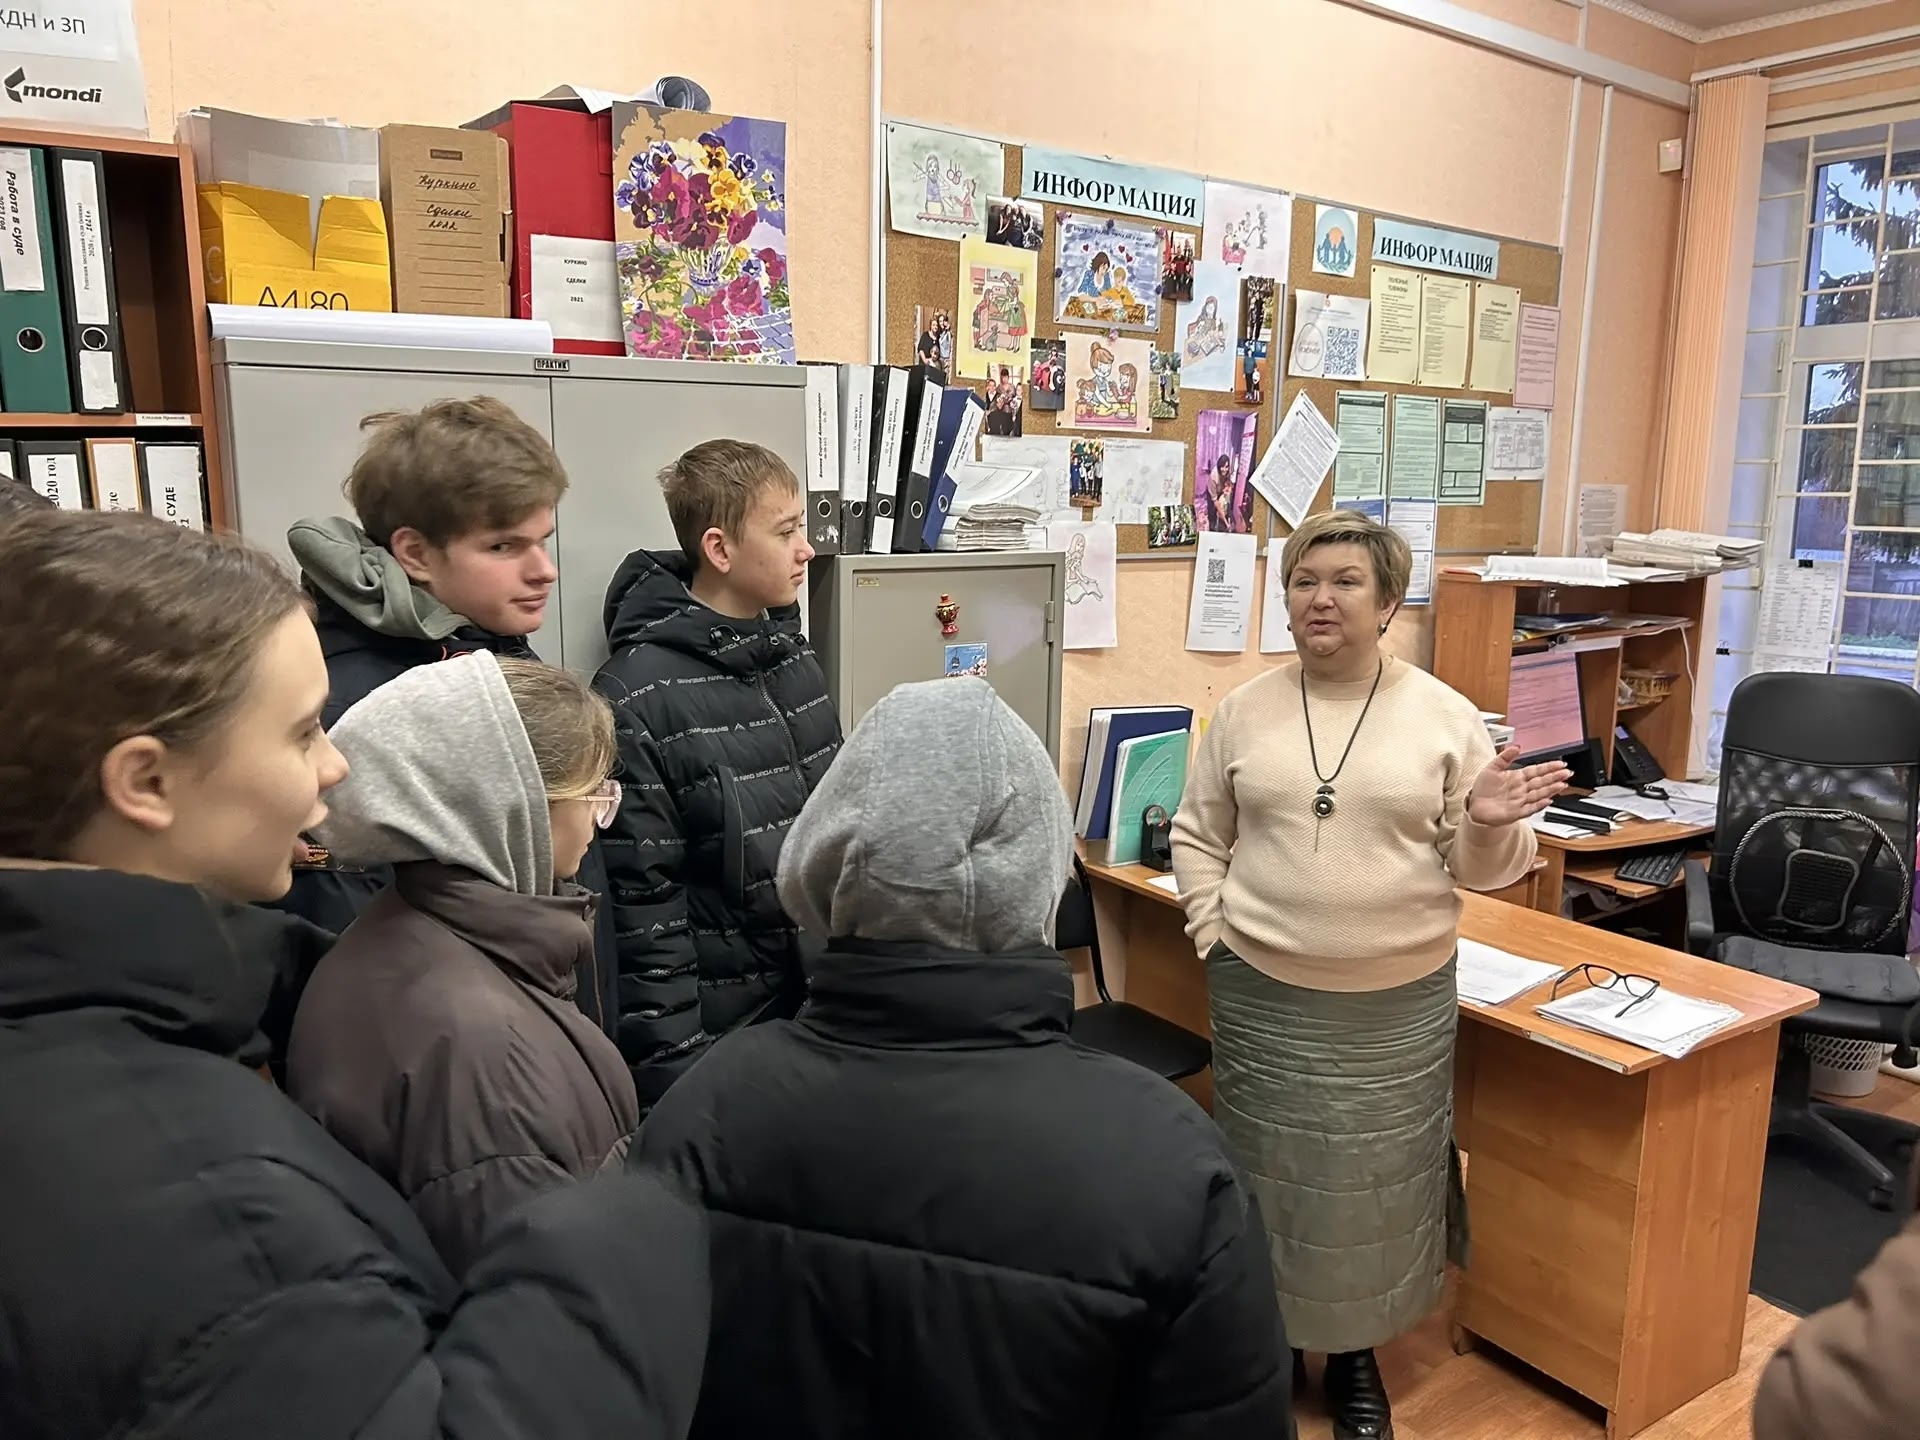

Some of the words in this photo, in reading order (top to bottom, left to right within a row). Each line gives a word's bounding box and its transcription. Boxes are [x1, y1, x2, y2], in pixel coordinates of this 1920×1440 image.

[43, 18, 55, 31] и
[61, 17, 86, 34] ЗП
[23, 85, 102, 103] mondi
[6, 170, 20, 216] Работа
[1032, 170, 1197, 219] ИНФОРМАЦИЯ
[12, 217, 20, 225] в
[14, 225, 25, 256] суде
[1380, 237, 1494, 274] ИНФОРМАЦИЯ
[566, 277, 587, 285] СДЕЛКИ
[536, 359, 568, 371] ПРАКТИК
[46, 457, 57, 477] год
[166, 486, 177, 516] СУДЕ
[631, 683, 656, 698] BUILD
